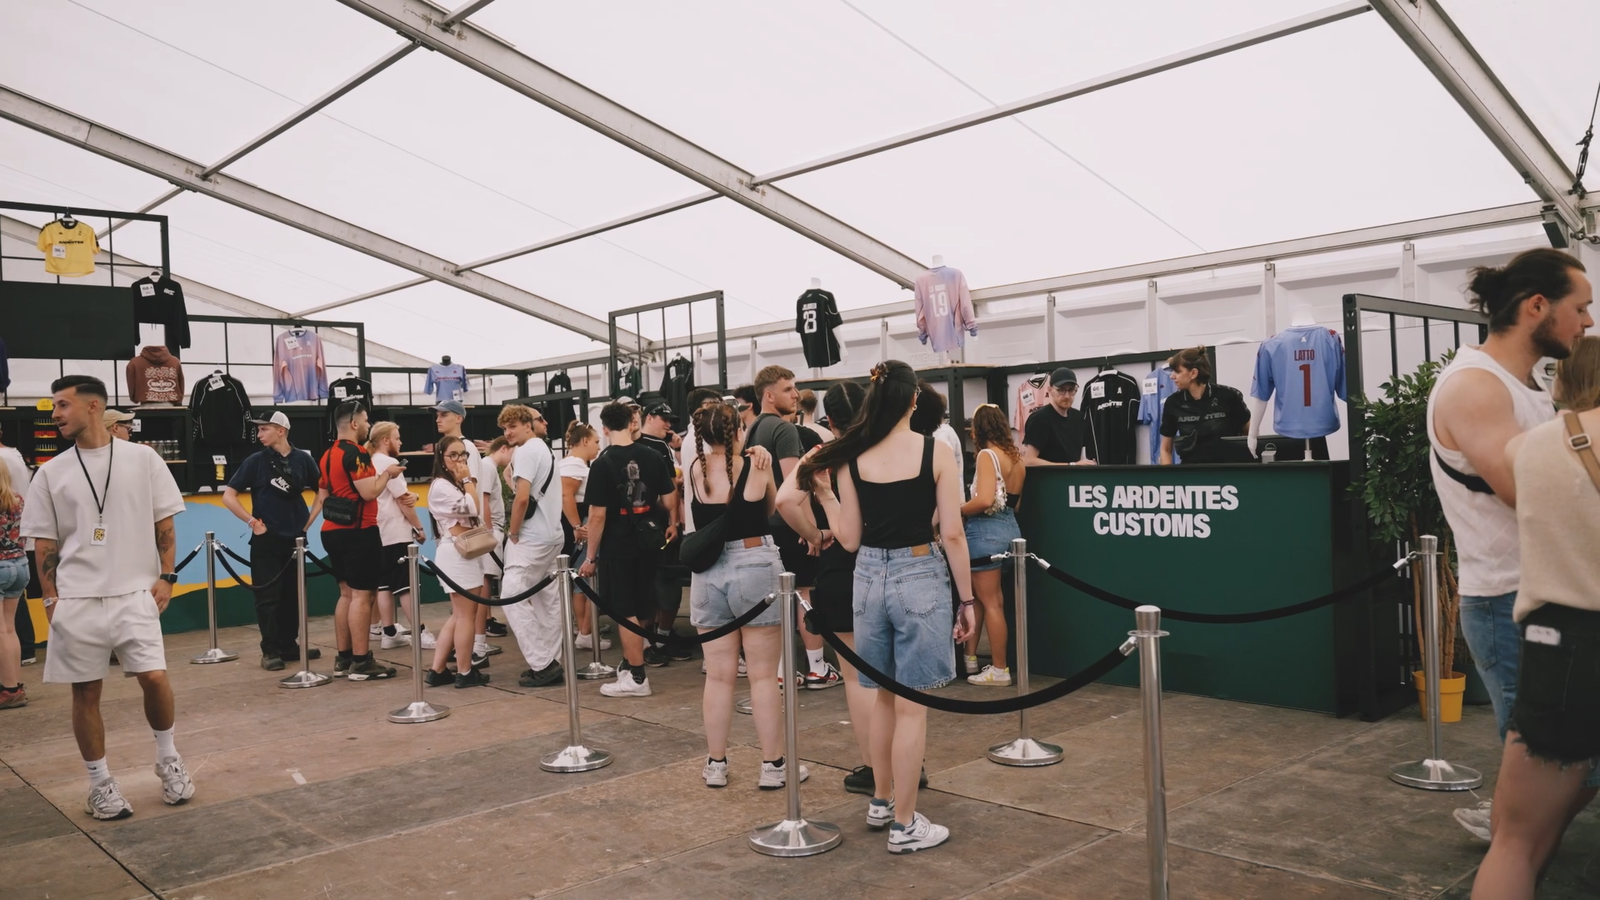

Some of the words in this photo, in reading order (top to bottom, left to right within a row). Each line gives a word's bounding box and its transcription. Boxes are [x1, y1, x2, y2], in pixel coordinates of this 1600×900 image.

[929, 291, 948, 318] 19
[1294, 349, 1315, 361] LATTO
[1298, 364, 1311, 407] 1
[1178, 412, 1226, 422] ARDNTES
[275, 476, 292, 489] NIKE
[1068, 485, 1108, 508] LES
[1112, 485, 1239, 510] ARDENTES
[1093, 512, 1211, 538] CUSTOMS
